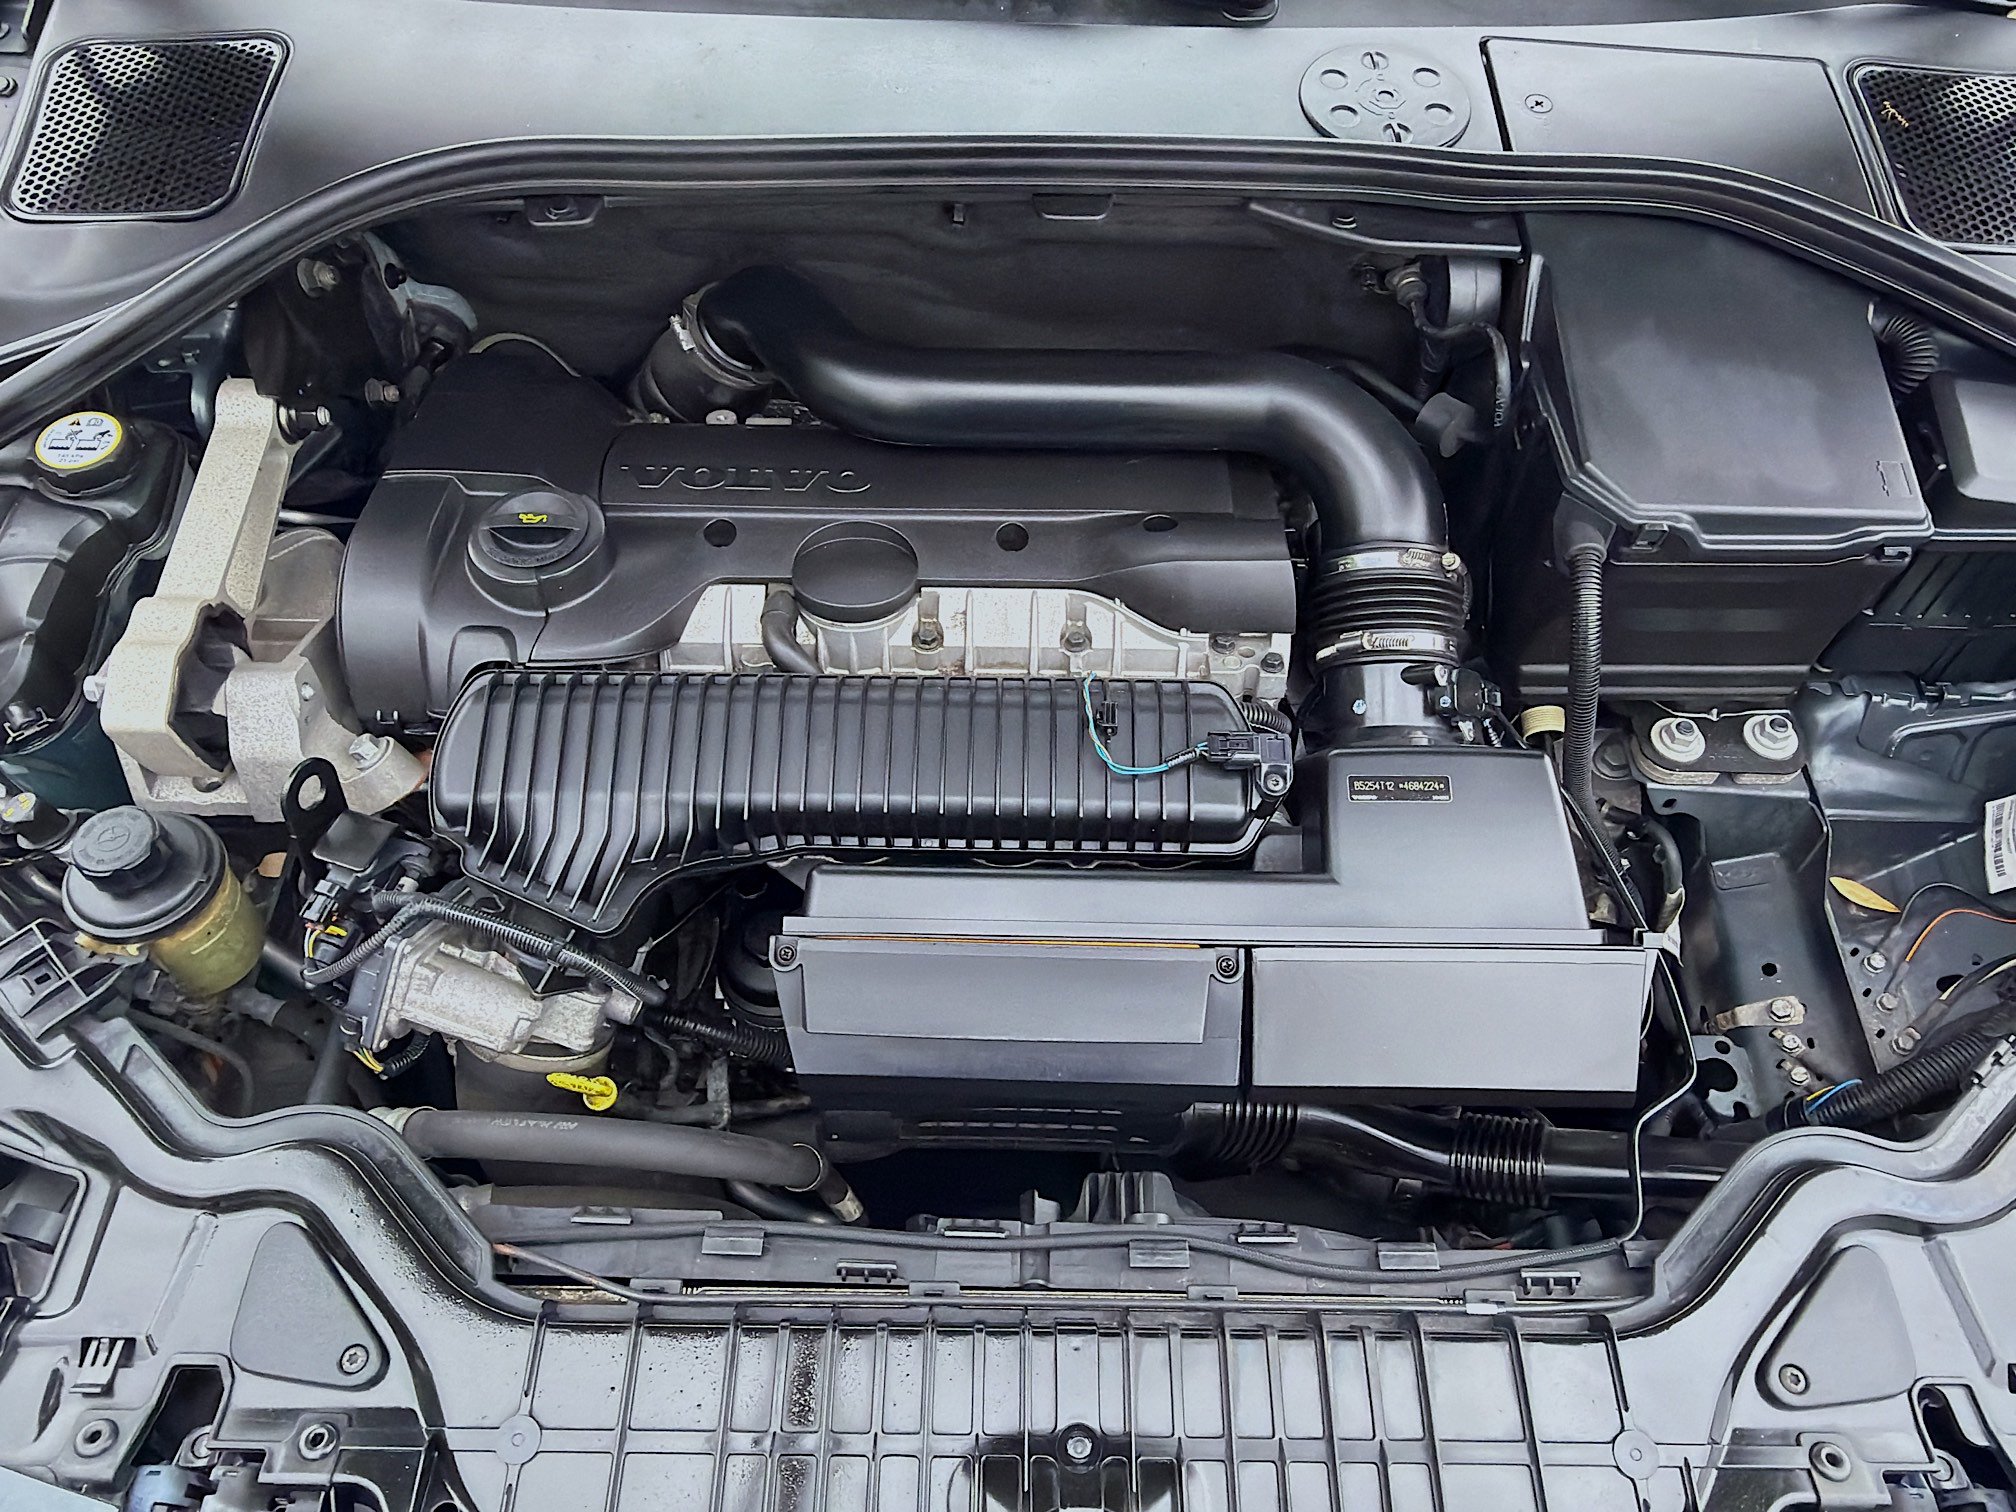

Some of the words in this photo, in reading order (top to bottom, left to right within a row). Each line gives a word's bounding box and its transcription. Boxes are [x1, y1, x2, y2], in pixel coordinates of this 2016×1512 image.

[1493, 384, 1506, 427] VOLVO
[620, 465, 872, 493] VOLVO
[1353, 780, 1395, 791] B5254T12
